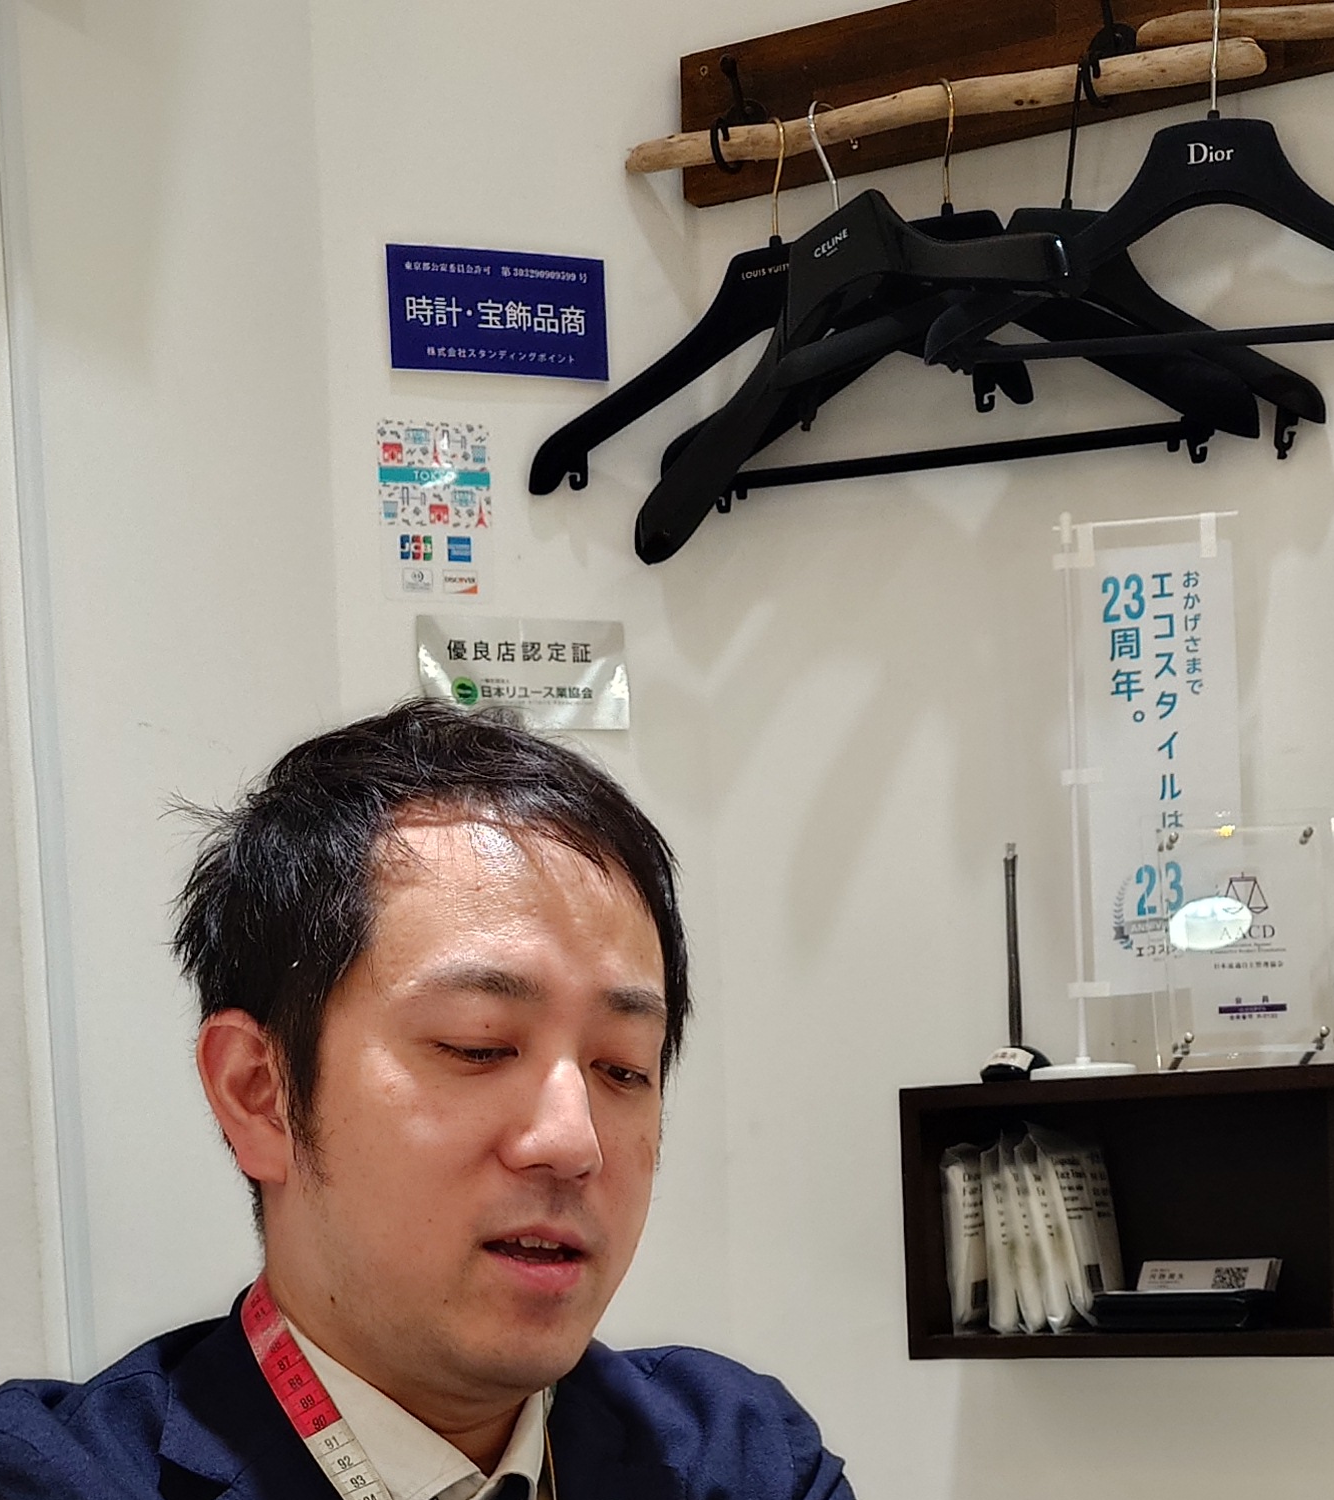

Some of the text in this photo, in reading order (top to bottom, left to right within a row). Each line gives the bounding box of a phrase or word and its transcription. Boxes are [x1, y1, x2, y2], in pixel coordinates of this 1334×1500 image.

[1187, 142, 1234, 165] Dior
[813, 228, 849, 258] CELINE
[741, 263, 789, 281] LOUIS VUITT
[405, 295, 586, 336] 時計・宝飾品商
[1182, 570, 1204, 695] おかげさまで
[447, 639, 592, 663] 優良店認定証
[481, 685, 593, 699] 日本リユース業協会
[1135, 861, 1184, 917] 23
[277, 1355, 291, 1371] 87
[288, 1373, 303, 1390] 88
[299, 1393, 315, 1410] 89
[312, 1414, 328, 1432] 90
[324, 1435, 340, 1450] 91
[337, 1455, 354, 1470] 92
[350, 1474, 367, 1489] 93
